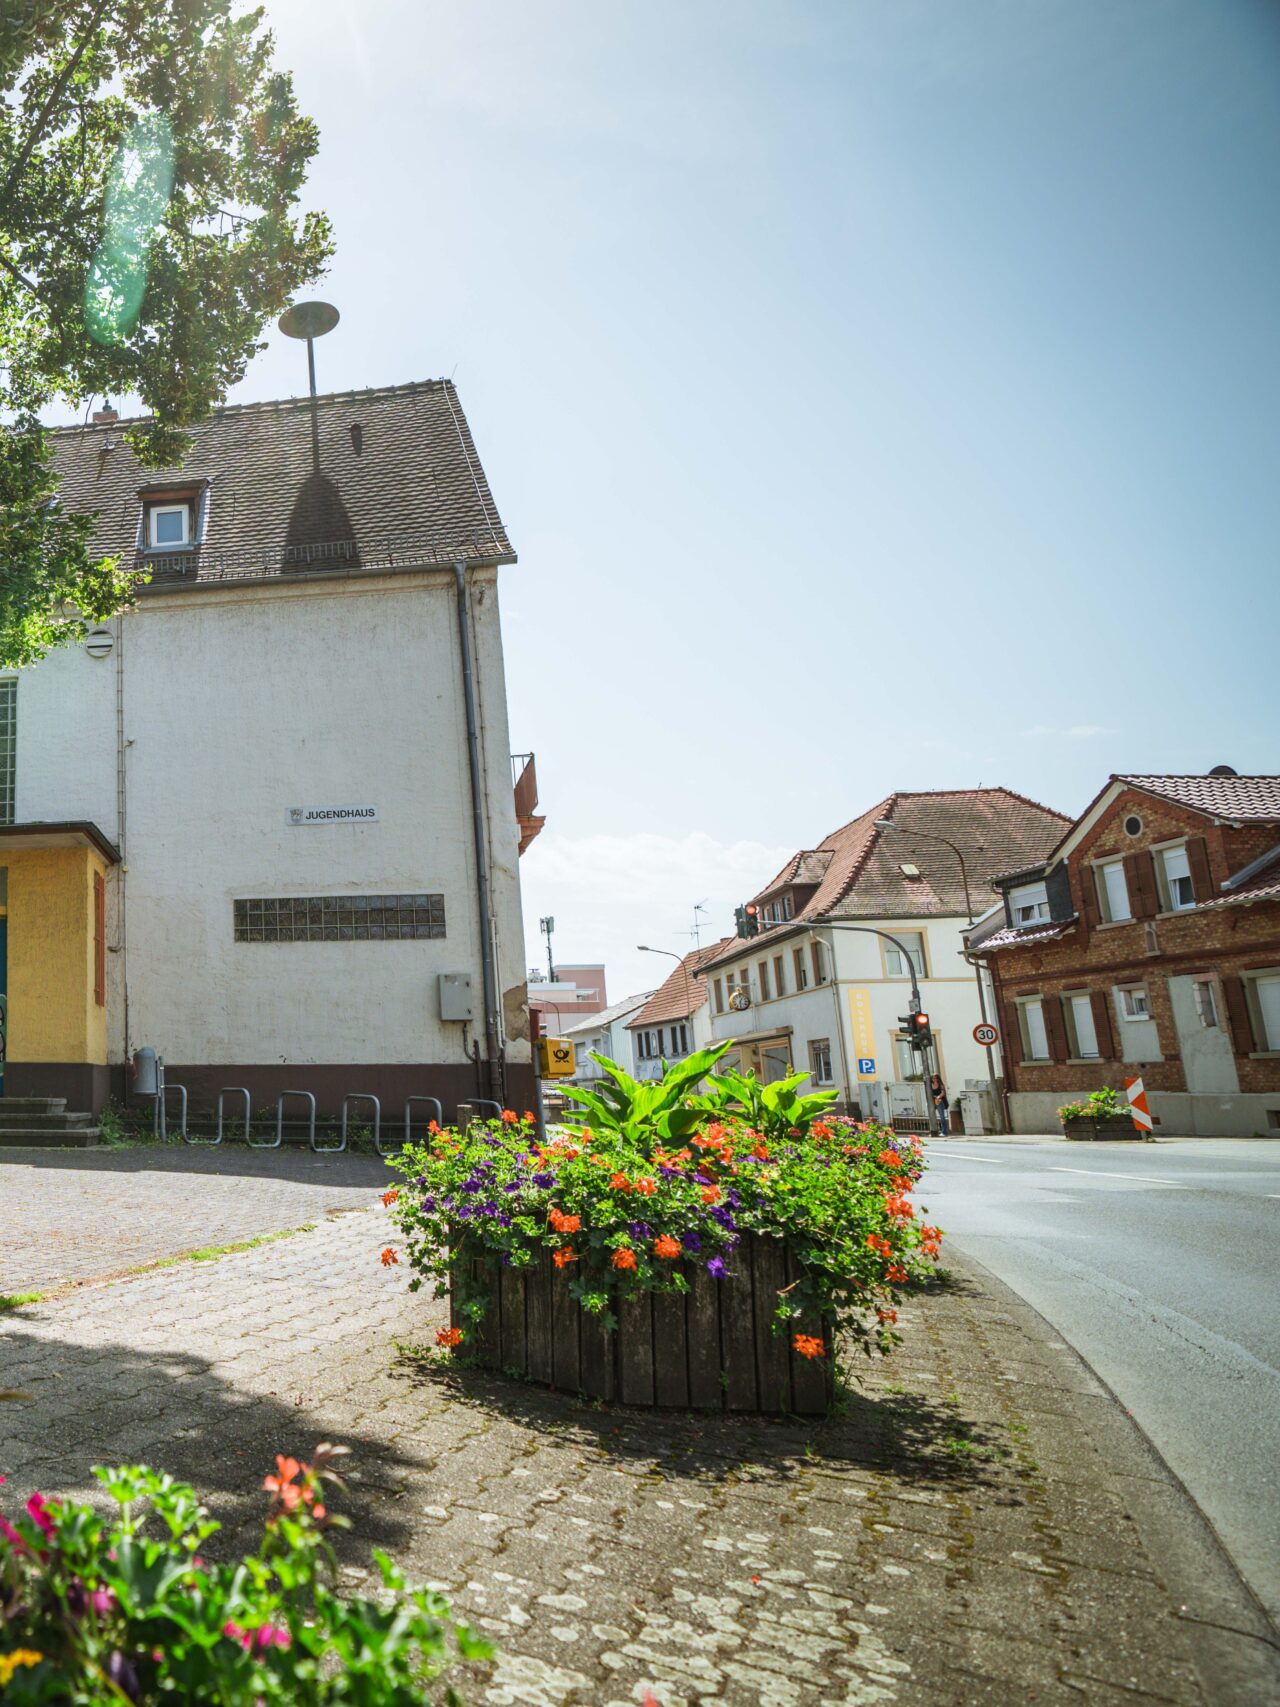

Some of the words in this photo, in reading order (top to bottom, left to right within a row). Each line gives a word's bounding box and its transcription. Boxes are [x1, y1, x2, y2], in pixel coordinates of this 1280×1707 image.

[305, 808, 376, 820] JUGENDHAUS
[978, 1029, 993, 1040] 30
[862, 1060, 872, 1073] P
